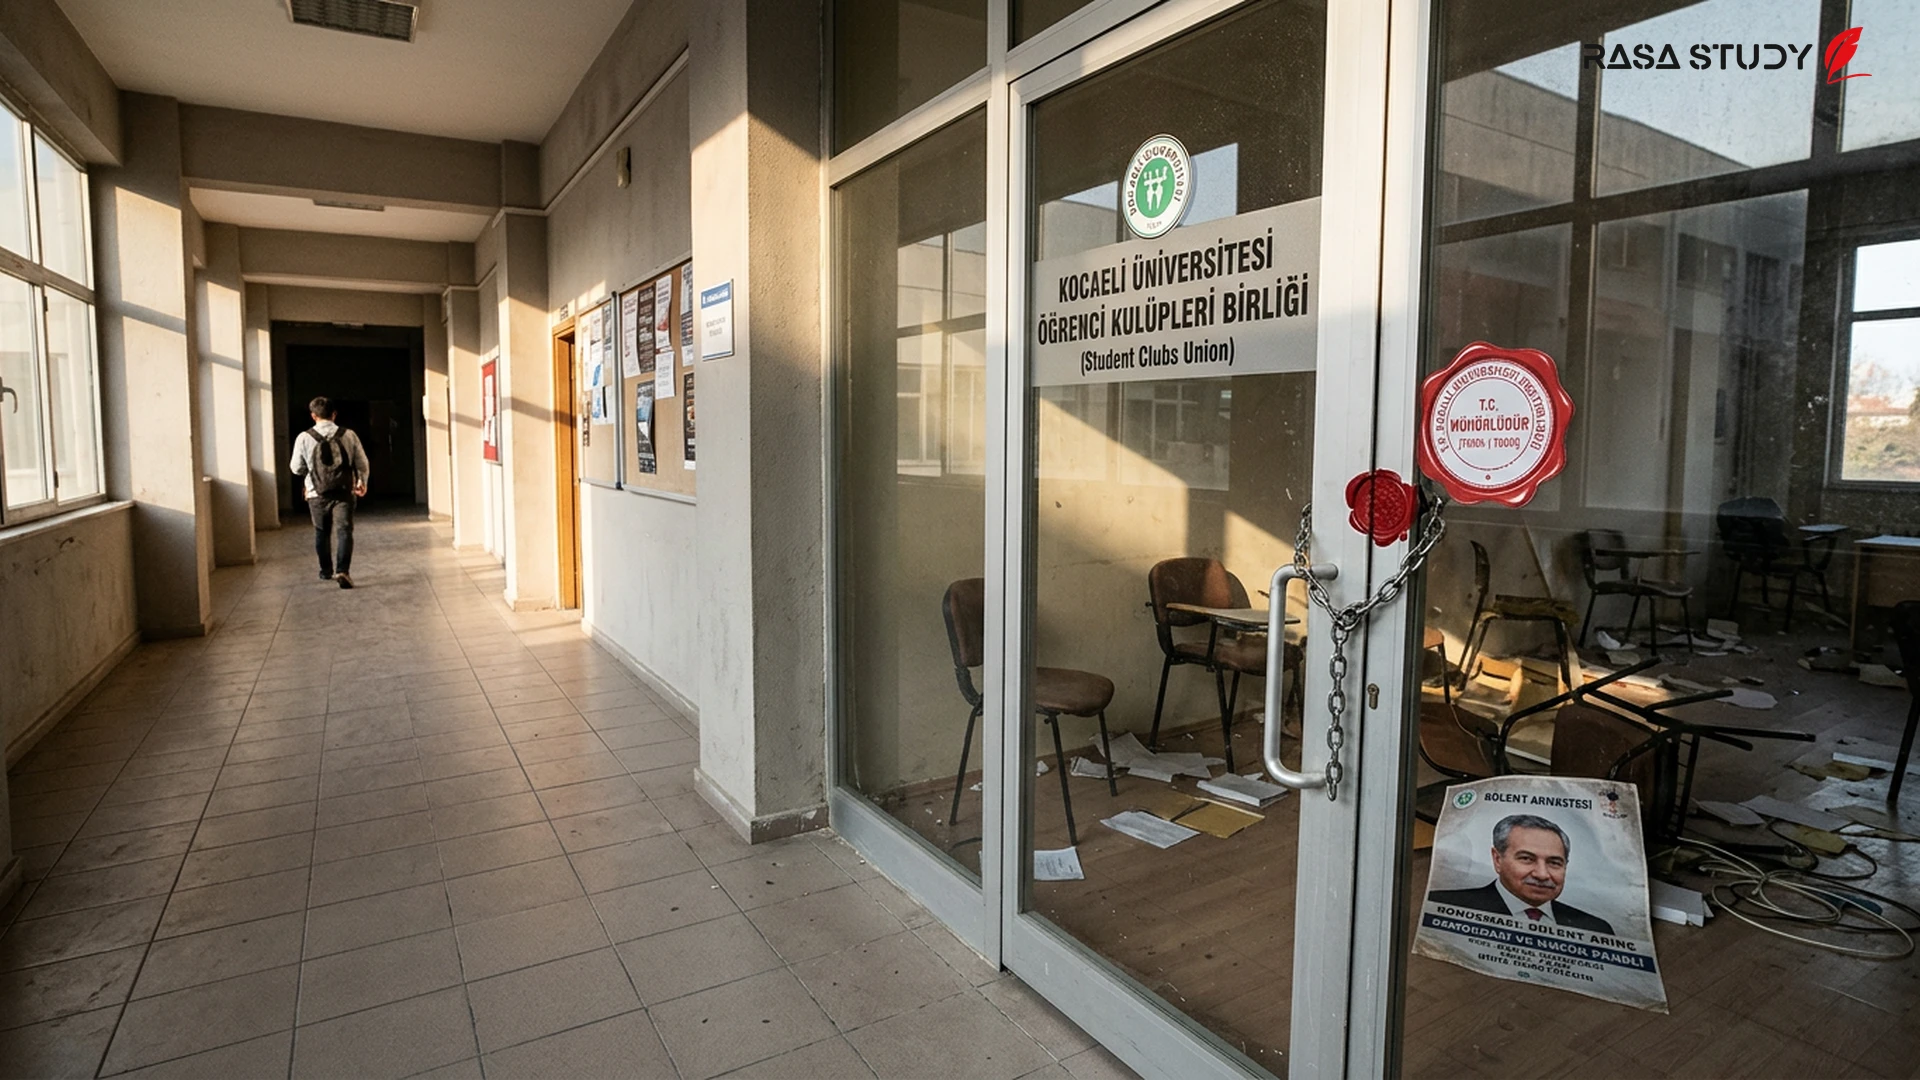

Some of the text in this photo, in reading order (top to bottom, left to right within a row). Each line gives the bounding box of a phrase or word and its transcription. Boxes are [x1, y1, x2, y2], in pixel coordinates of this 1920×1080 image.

[1059, 227, 1273, 303] KOCAELİ ÜNİVERSİTESİ
[1111, 287, 1215, 338] KULÜPLERİ
[1223, 273, 1308, 324] BİRLİĞİ
[1080, 336, 1235, 376] (Student Clubs Union)
